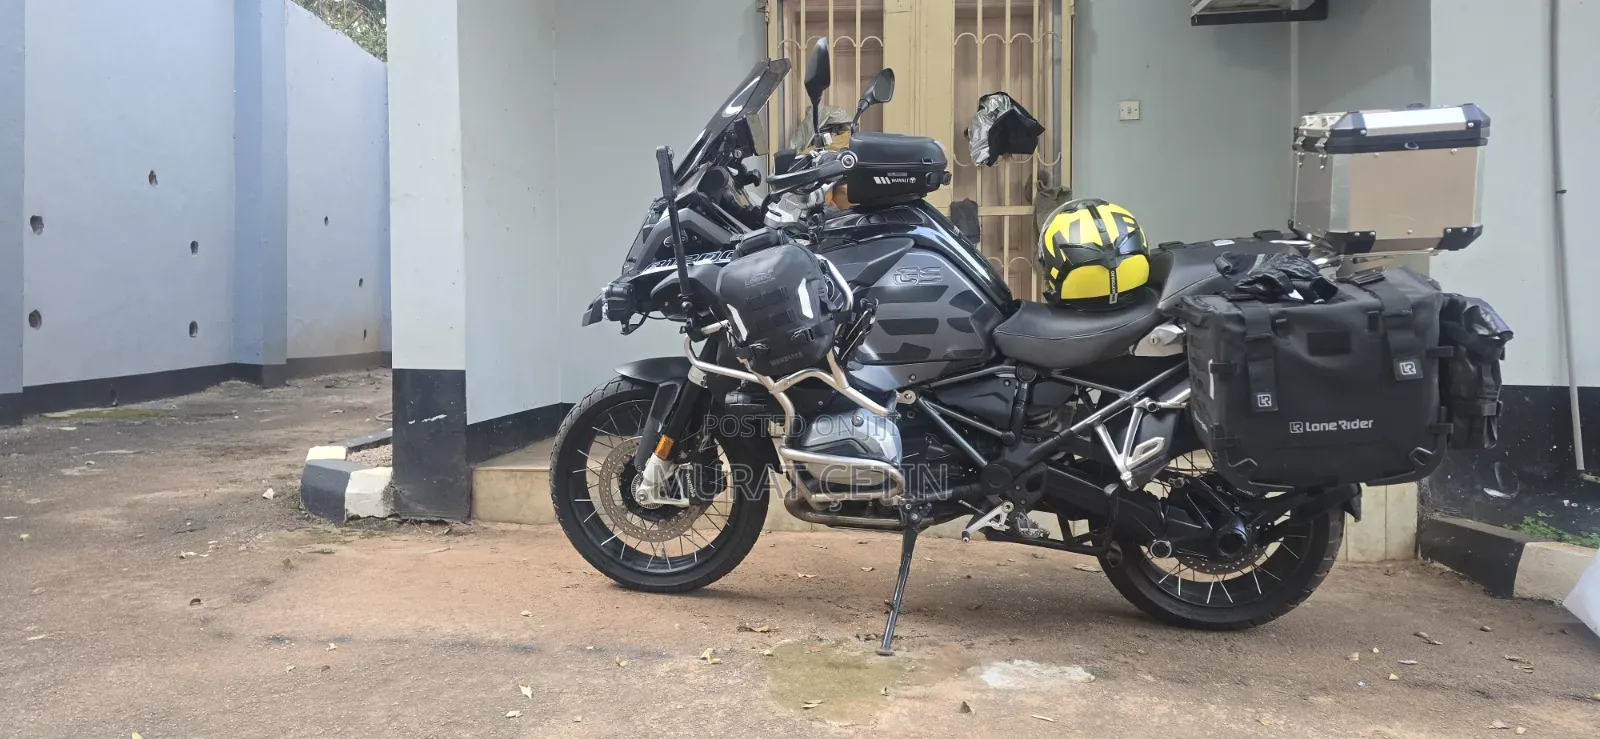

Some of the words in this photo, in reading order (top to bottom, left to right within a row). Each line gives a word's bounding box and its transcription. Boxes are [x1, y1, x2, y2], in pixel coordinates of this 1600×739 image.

[893, 266, 943, 285] GS
[1305, 421, 1337, 432] Lone
[1338, 418, 1374, 430] Rider
